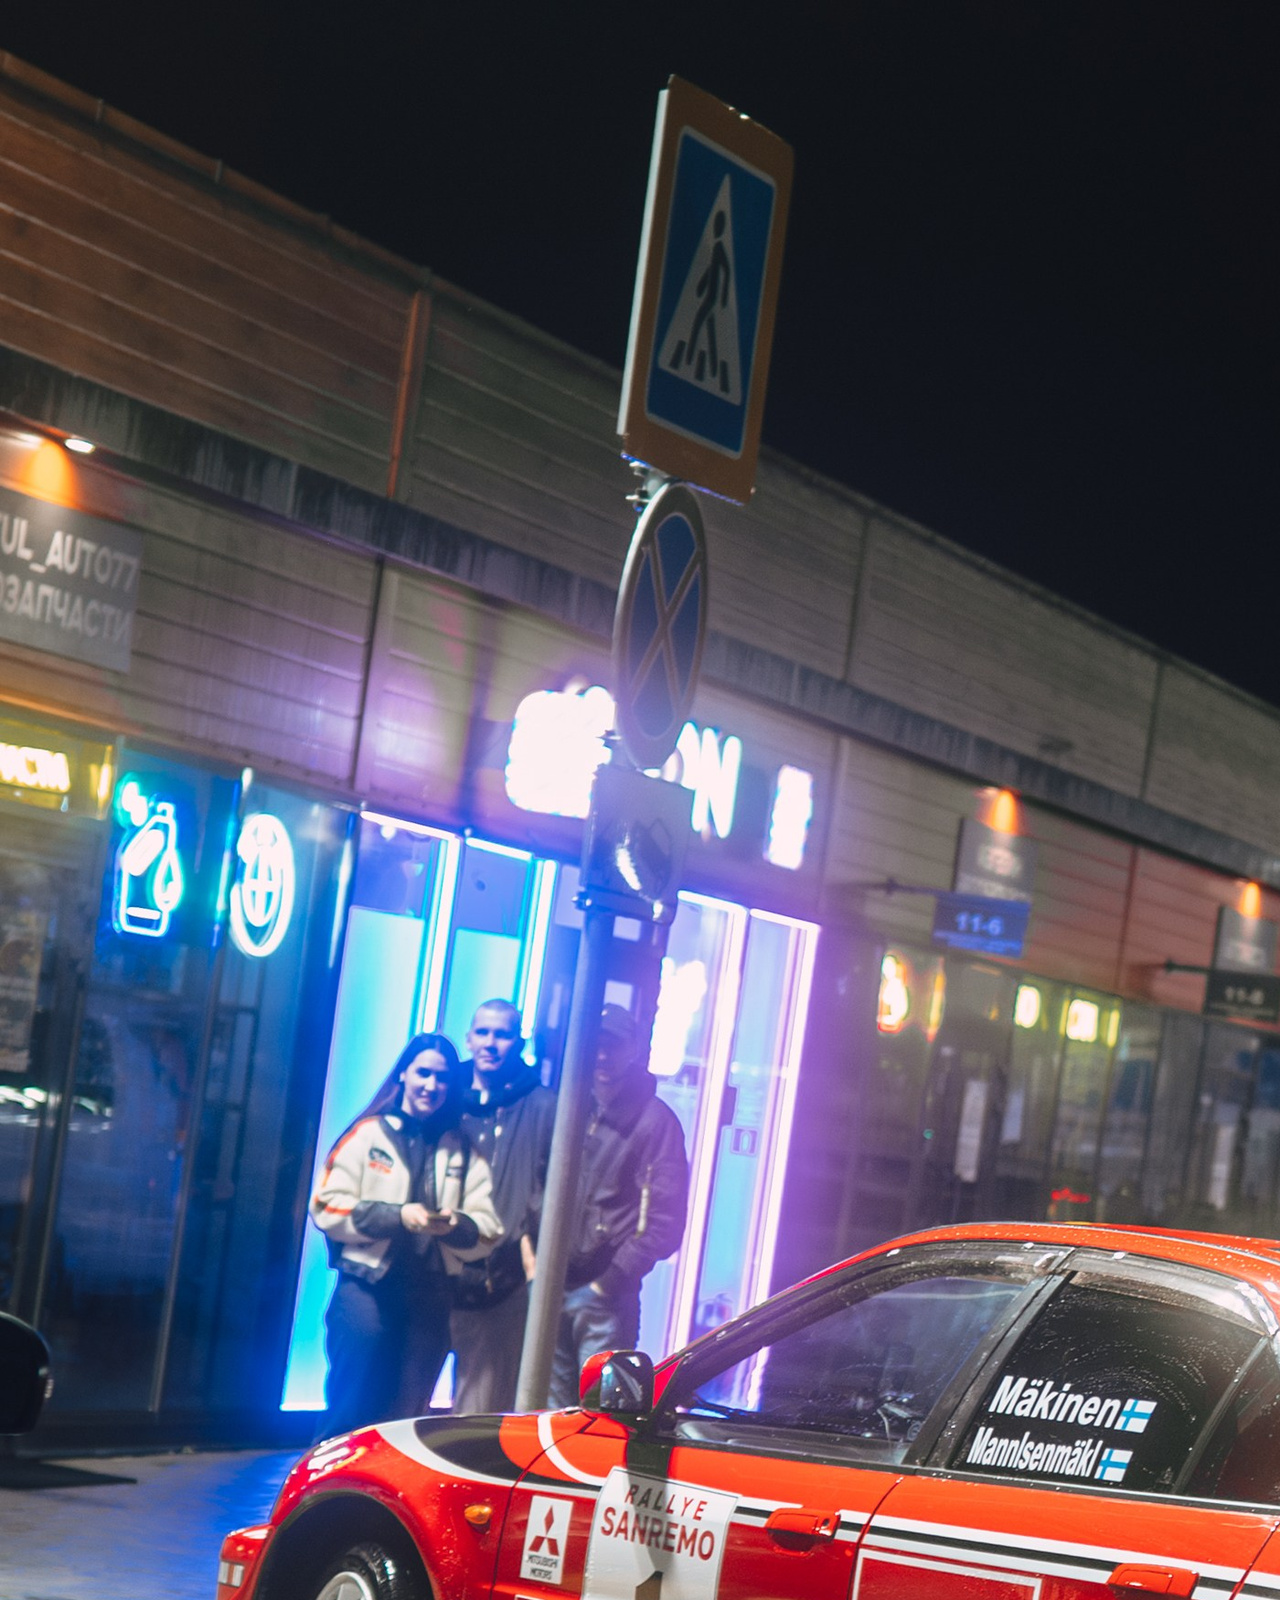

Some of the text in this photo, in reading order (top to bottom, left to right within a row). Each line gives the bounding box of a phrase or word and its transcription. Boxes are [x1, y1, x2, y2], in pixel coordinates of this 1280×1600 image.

[0, 512, 140, 592] UL_AUTO77
[988, 1375, 1121, 1429] Mäkinen
[625, 1483, 708, 1521] RALLYE
[600, 1506, 715, 1561] SANREMO
